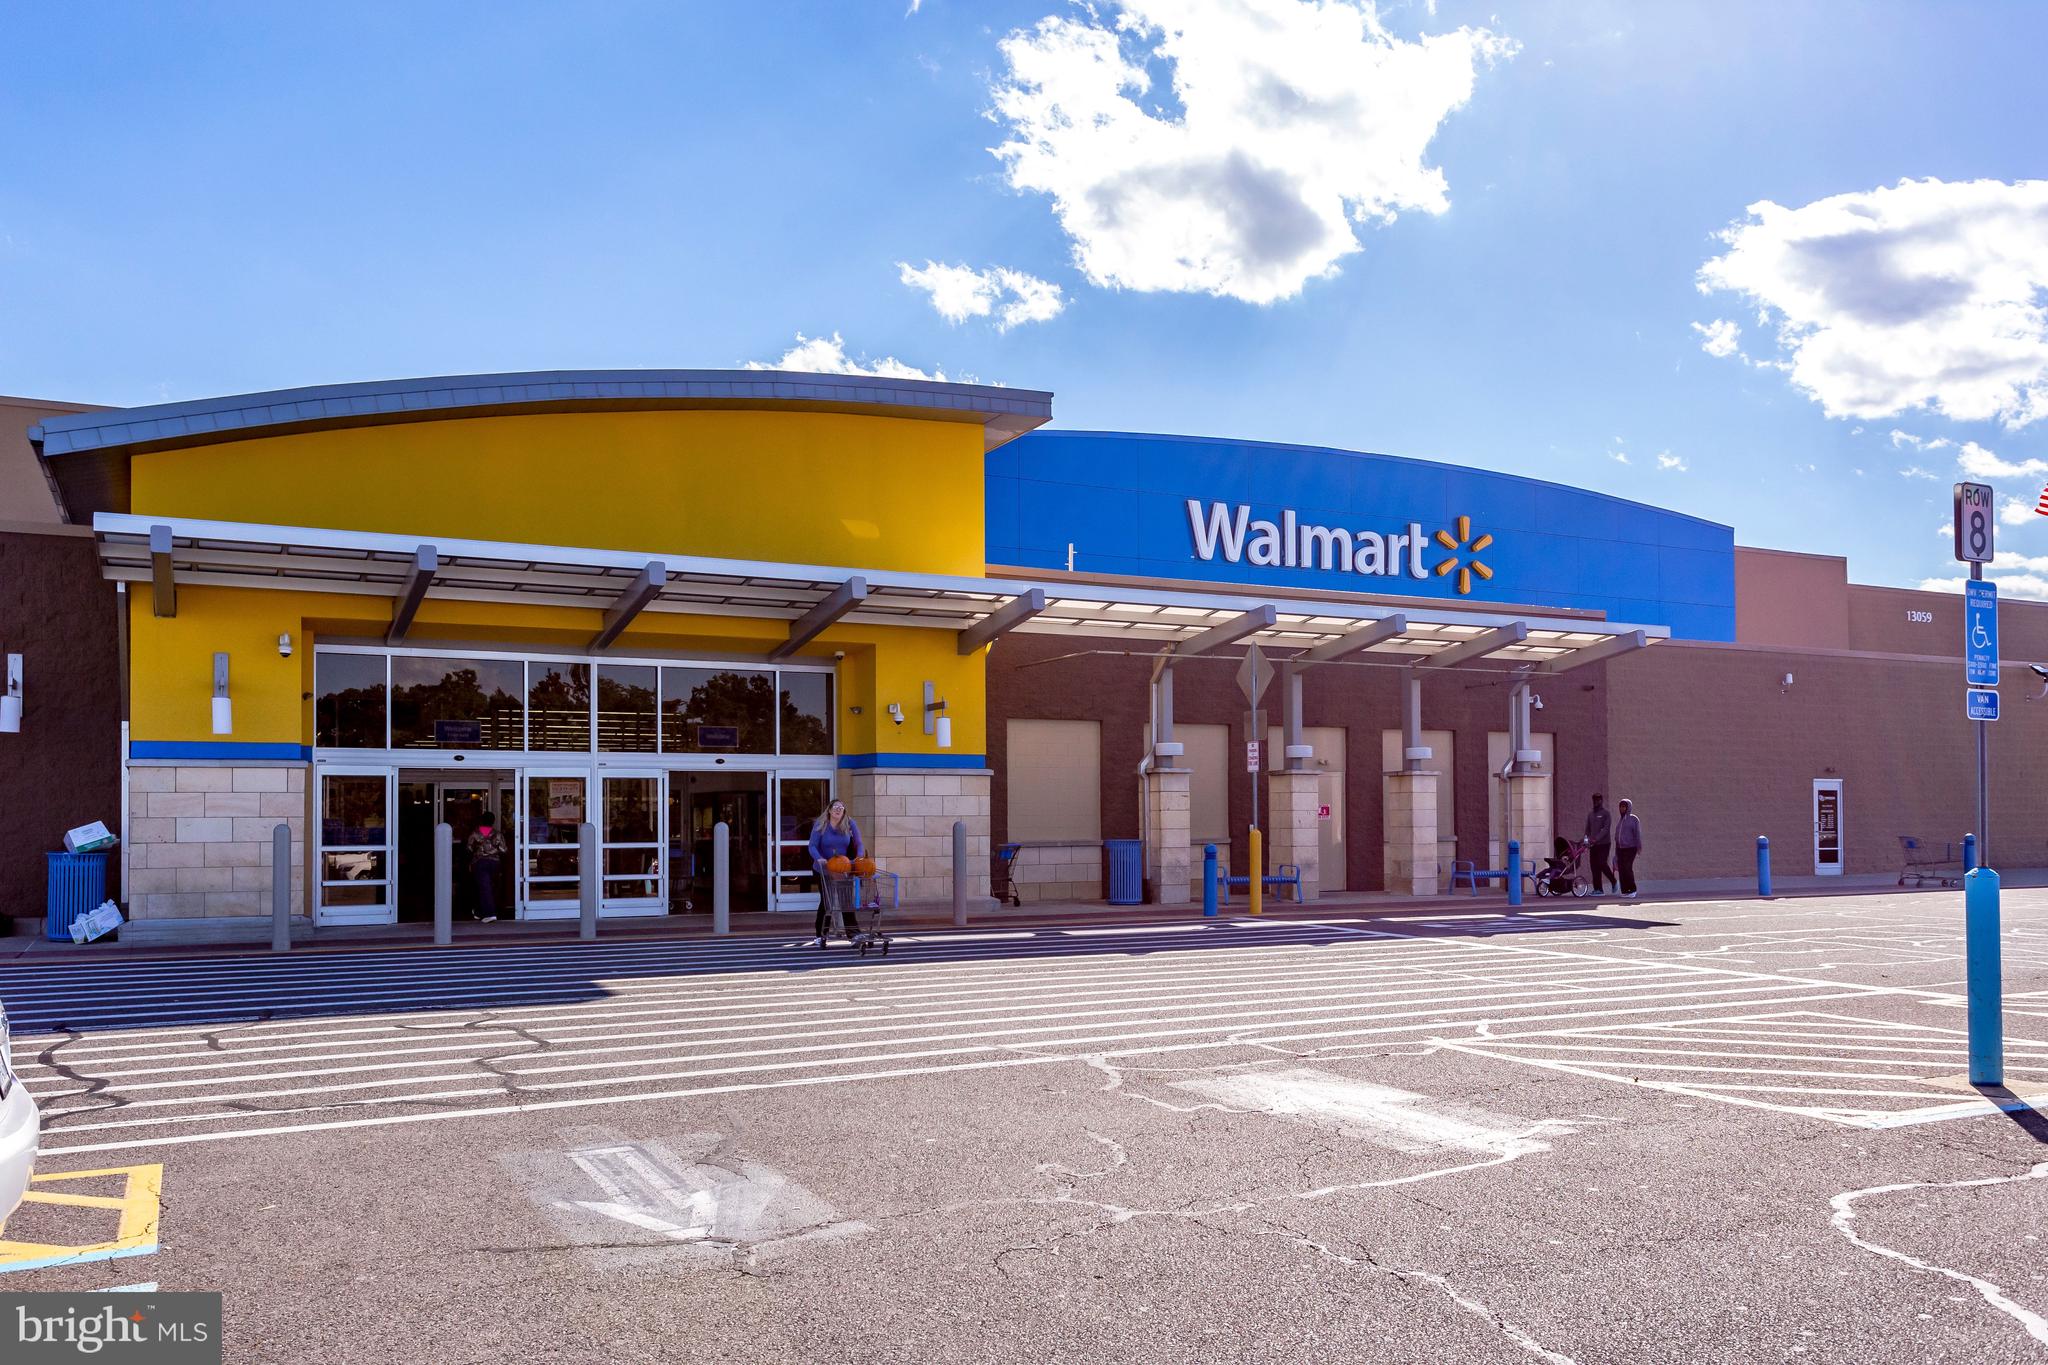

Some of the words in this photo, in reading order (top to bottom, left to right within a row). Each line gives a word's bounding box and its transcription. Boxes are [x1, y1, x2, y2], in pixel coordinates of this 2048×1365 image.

[1965, 488, 1990, 508] ROW
[1187, 499, 1429, 579] Walmart
[1969, 510, 1986, 554] 8
[1906, 610, 1933, 623] 13059
[1976, 694, 1990, 704] VAN
[1970, 706, 1996, 717] ACCESSIBLE
